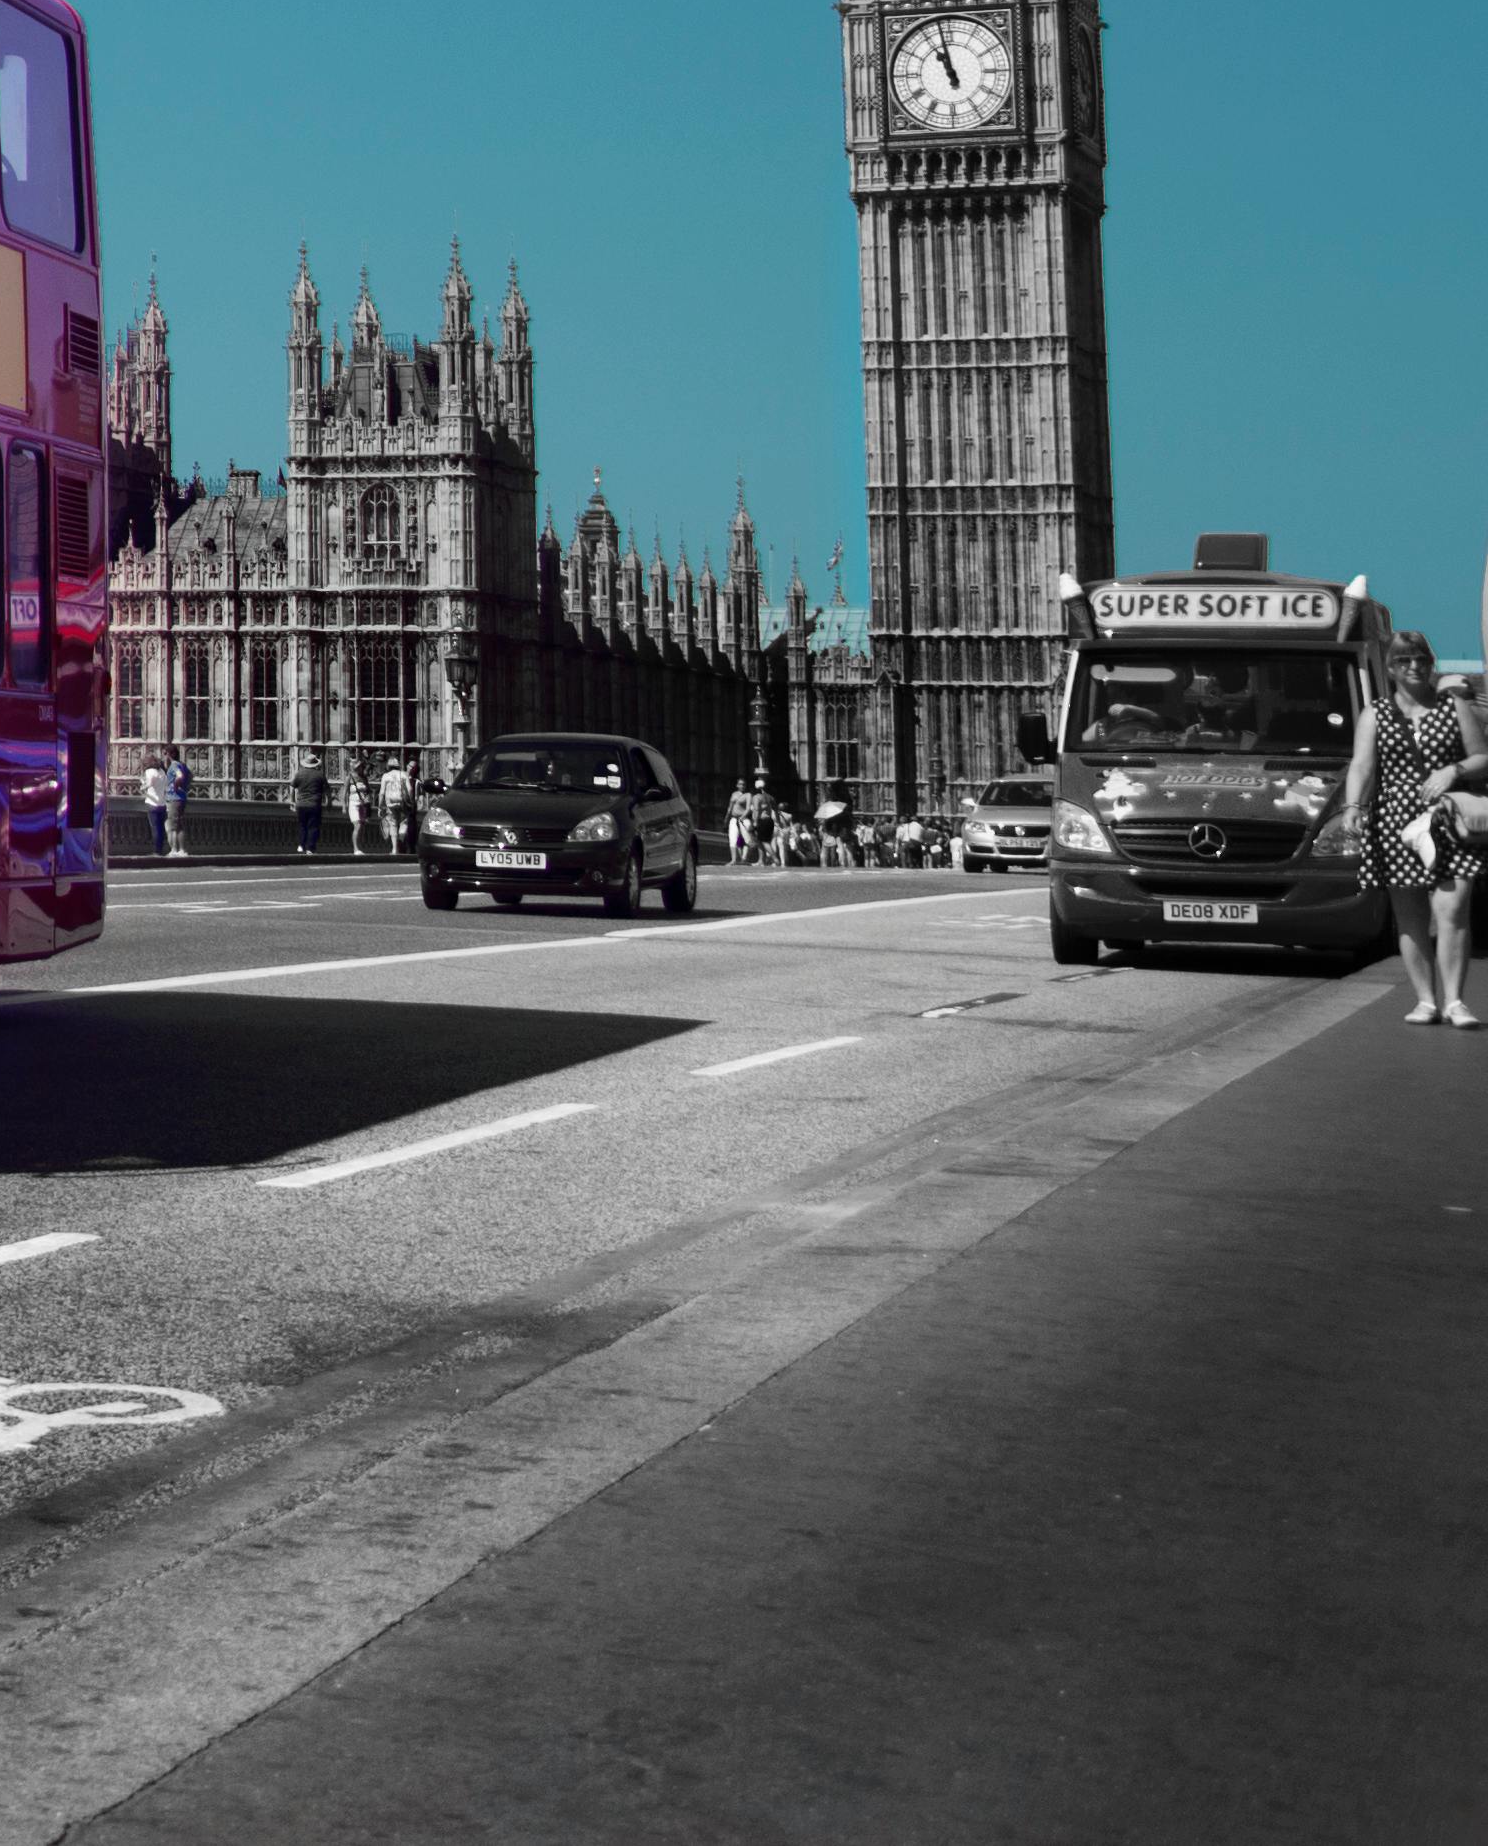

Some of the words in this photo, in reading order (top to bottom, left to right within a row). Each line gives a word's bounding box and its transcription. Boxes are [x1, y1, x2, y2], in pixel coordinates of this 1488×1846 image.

[1099, 594, 1188, 617] SUPER
[1198, 594, 1269, 617] SOFT
[1282, 594, 1324, 617] ICE
[481, 853, 512, 865] LY05
[1171, 904, 1213, 918] DE08
[1218, 905, 1250, 919] XDF
